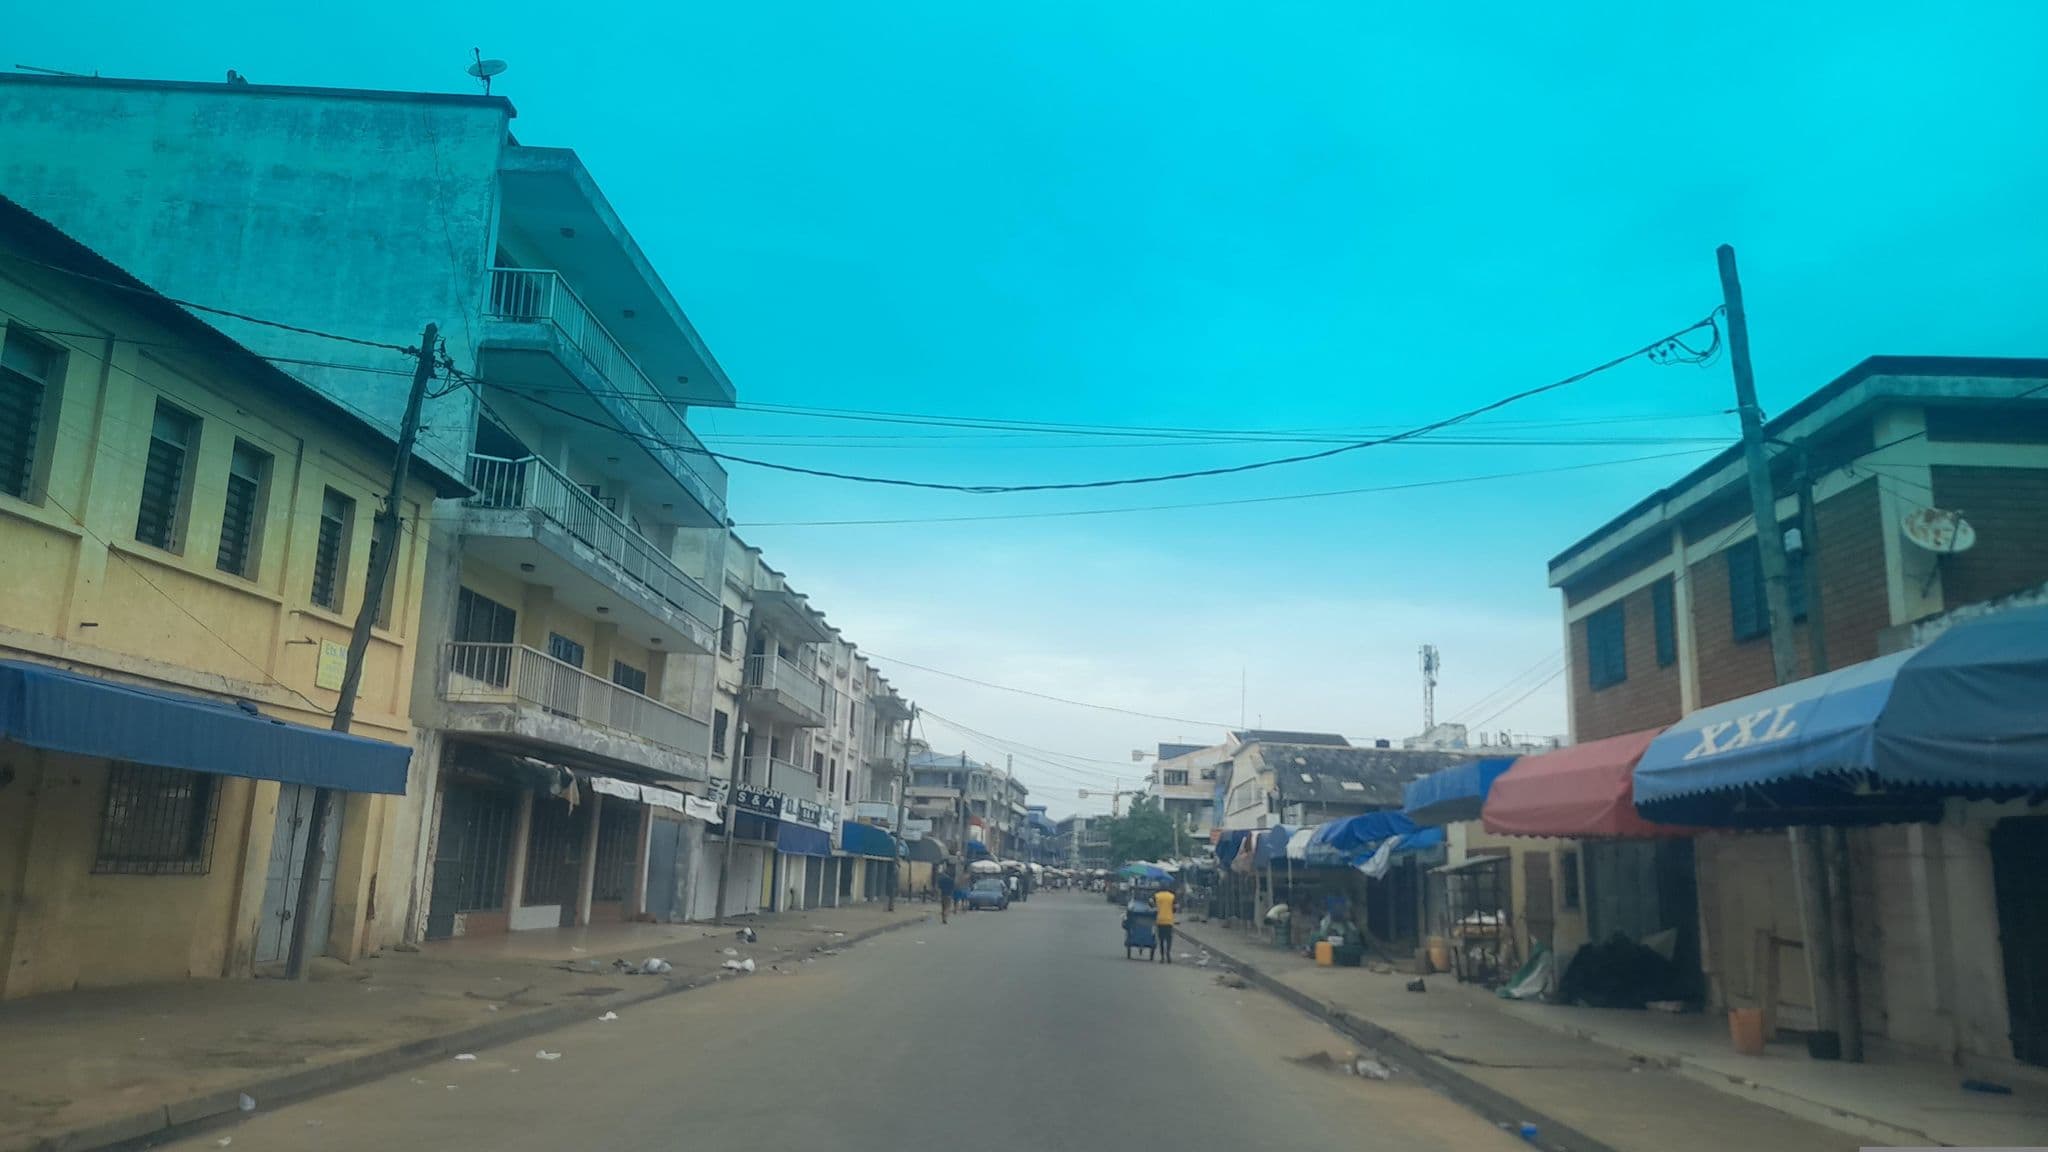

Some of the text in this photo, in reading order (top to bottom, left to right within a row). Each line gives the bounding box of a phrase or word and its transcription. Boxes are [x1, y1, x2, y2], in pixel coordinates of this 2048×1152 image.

[1682, 703, 1797, 760] XXL
[736, 783, 782, 799] MAISON
[738, 792, 747, 803] S
[752, 794, 760, 805] &
[765, 798, 775, 809] A
